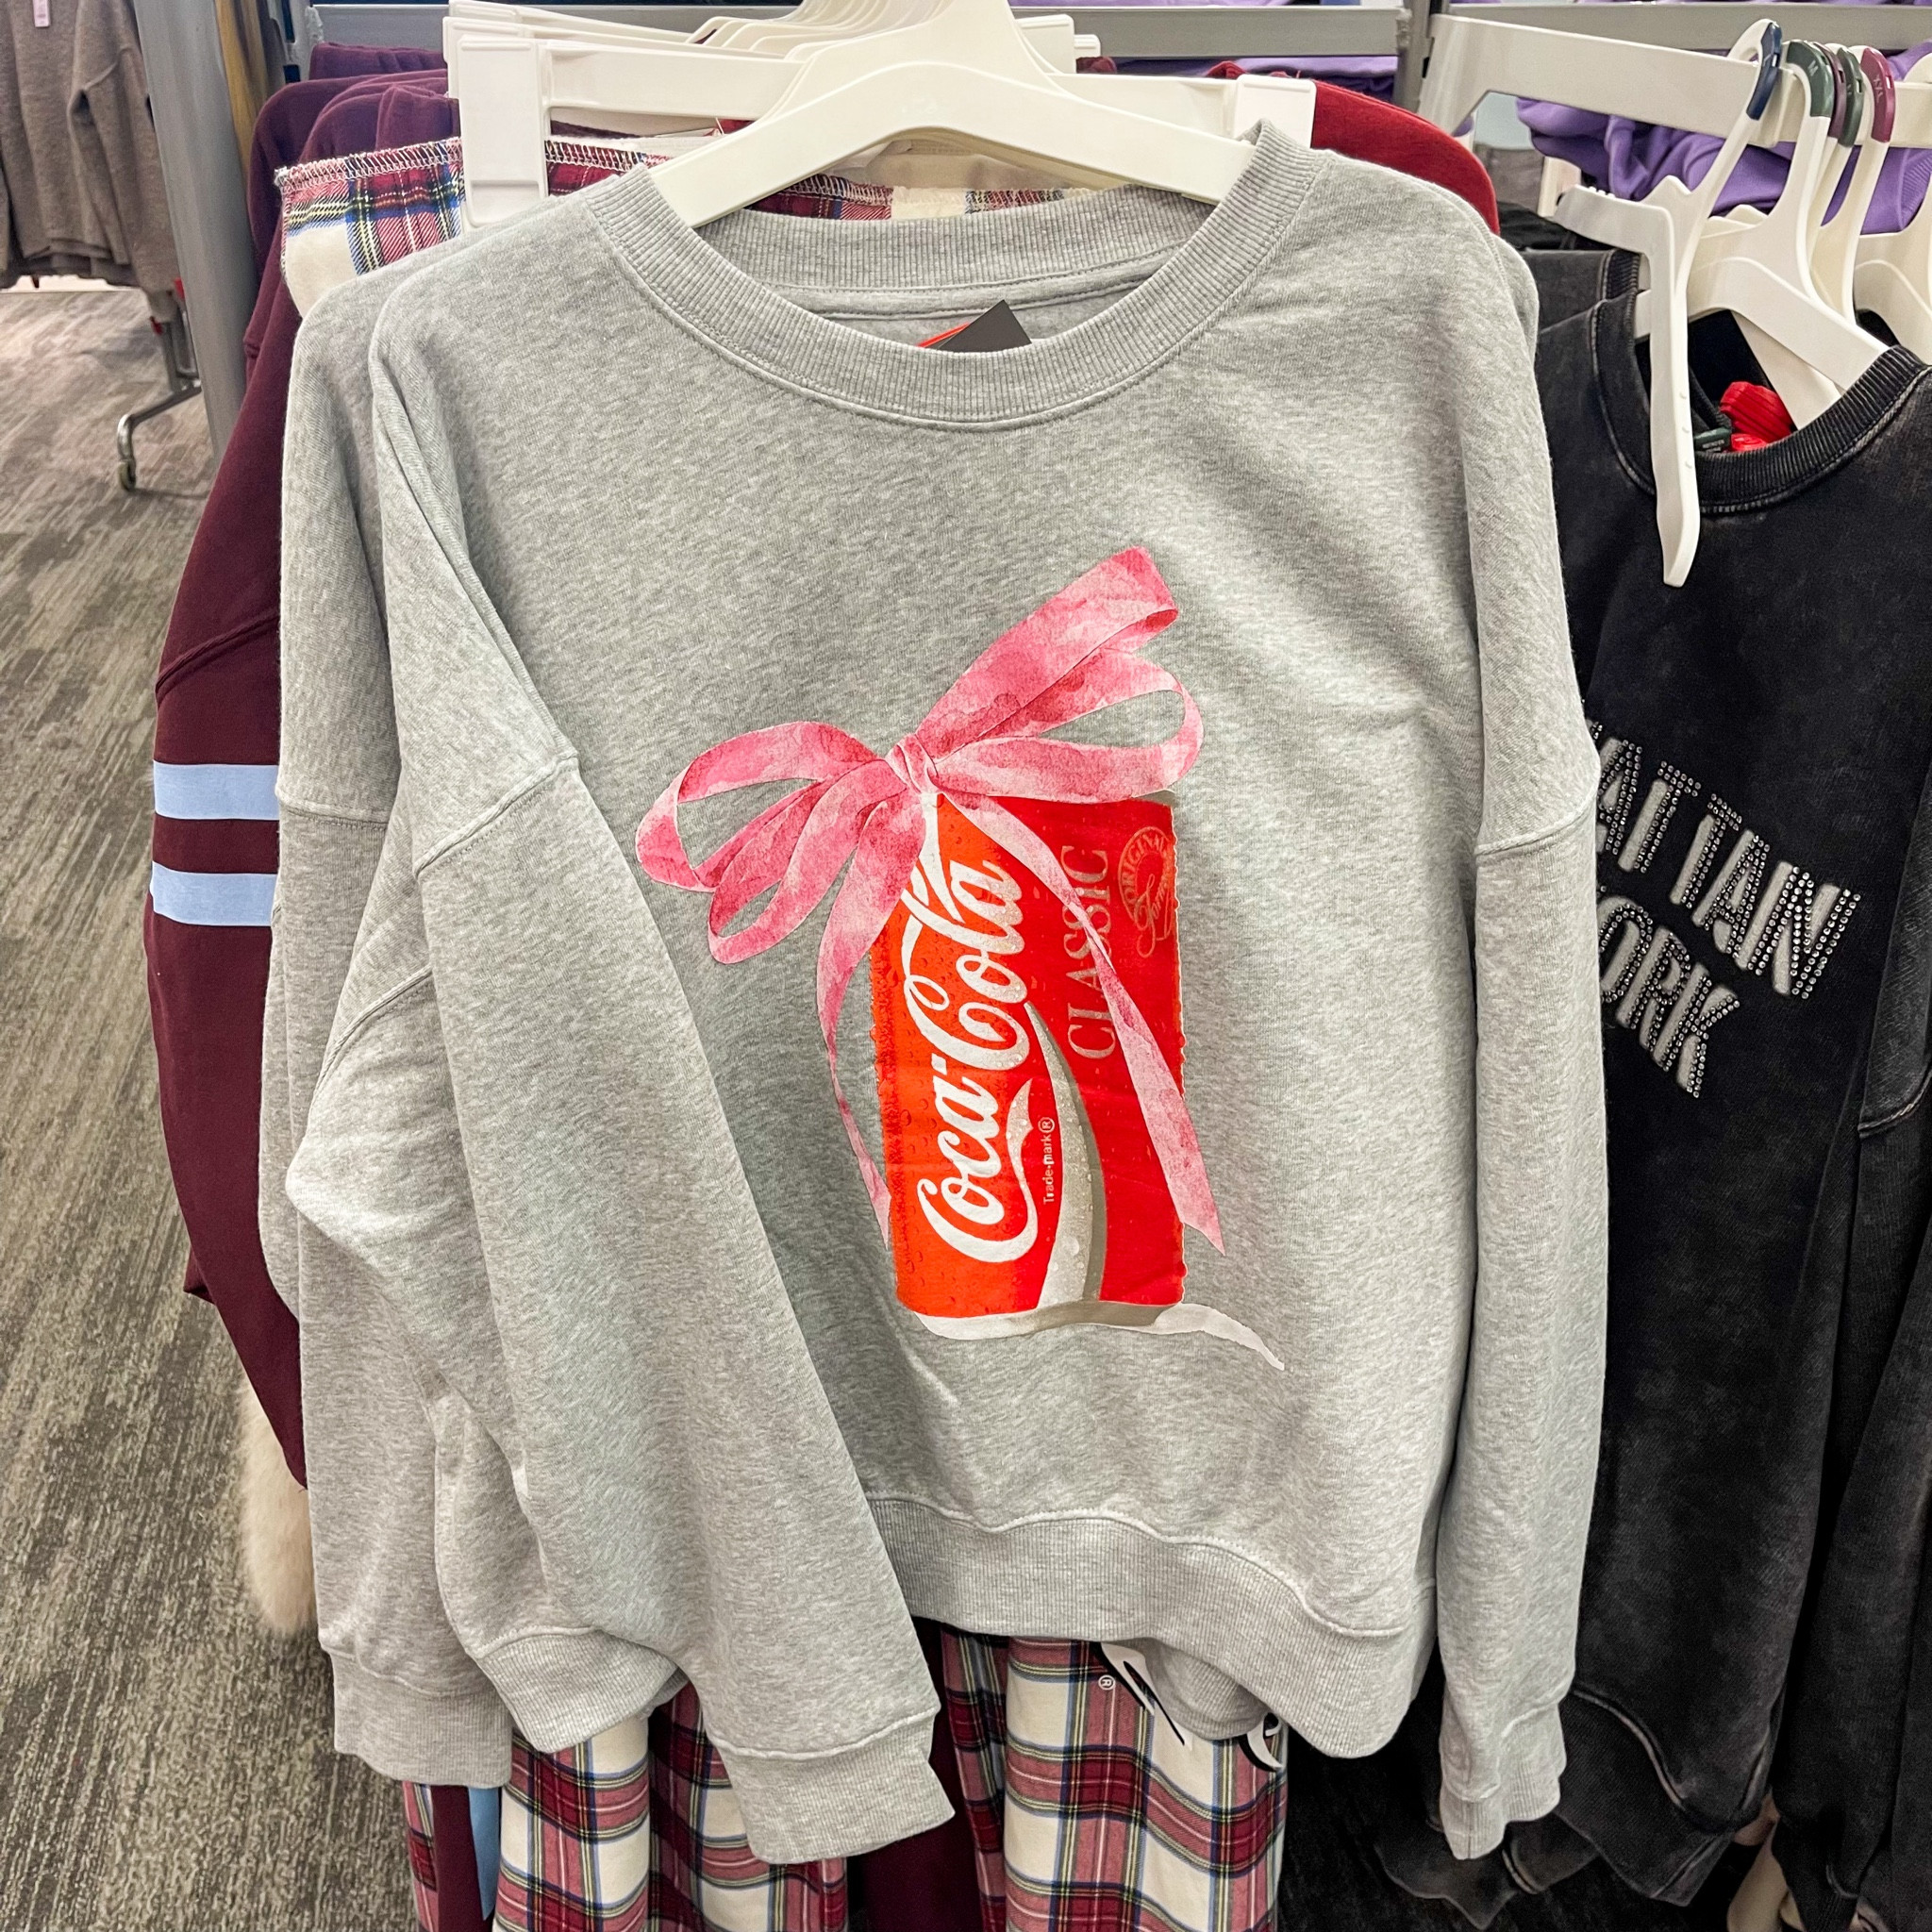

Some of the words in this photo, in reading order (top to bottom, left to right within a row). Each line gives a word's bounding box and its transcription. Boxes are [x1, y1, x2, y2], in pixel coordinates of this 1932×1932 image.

[1594, 723, 1862, 1001] ATTAN
[1597, 885, 1741, 1099] ORK
[902, 797, 1036, 1264] Coca-Cola
